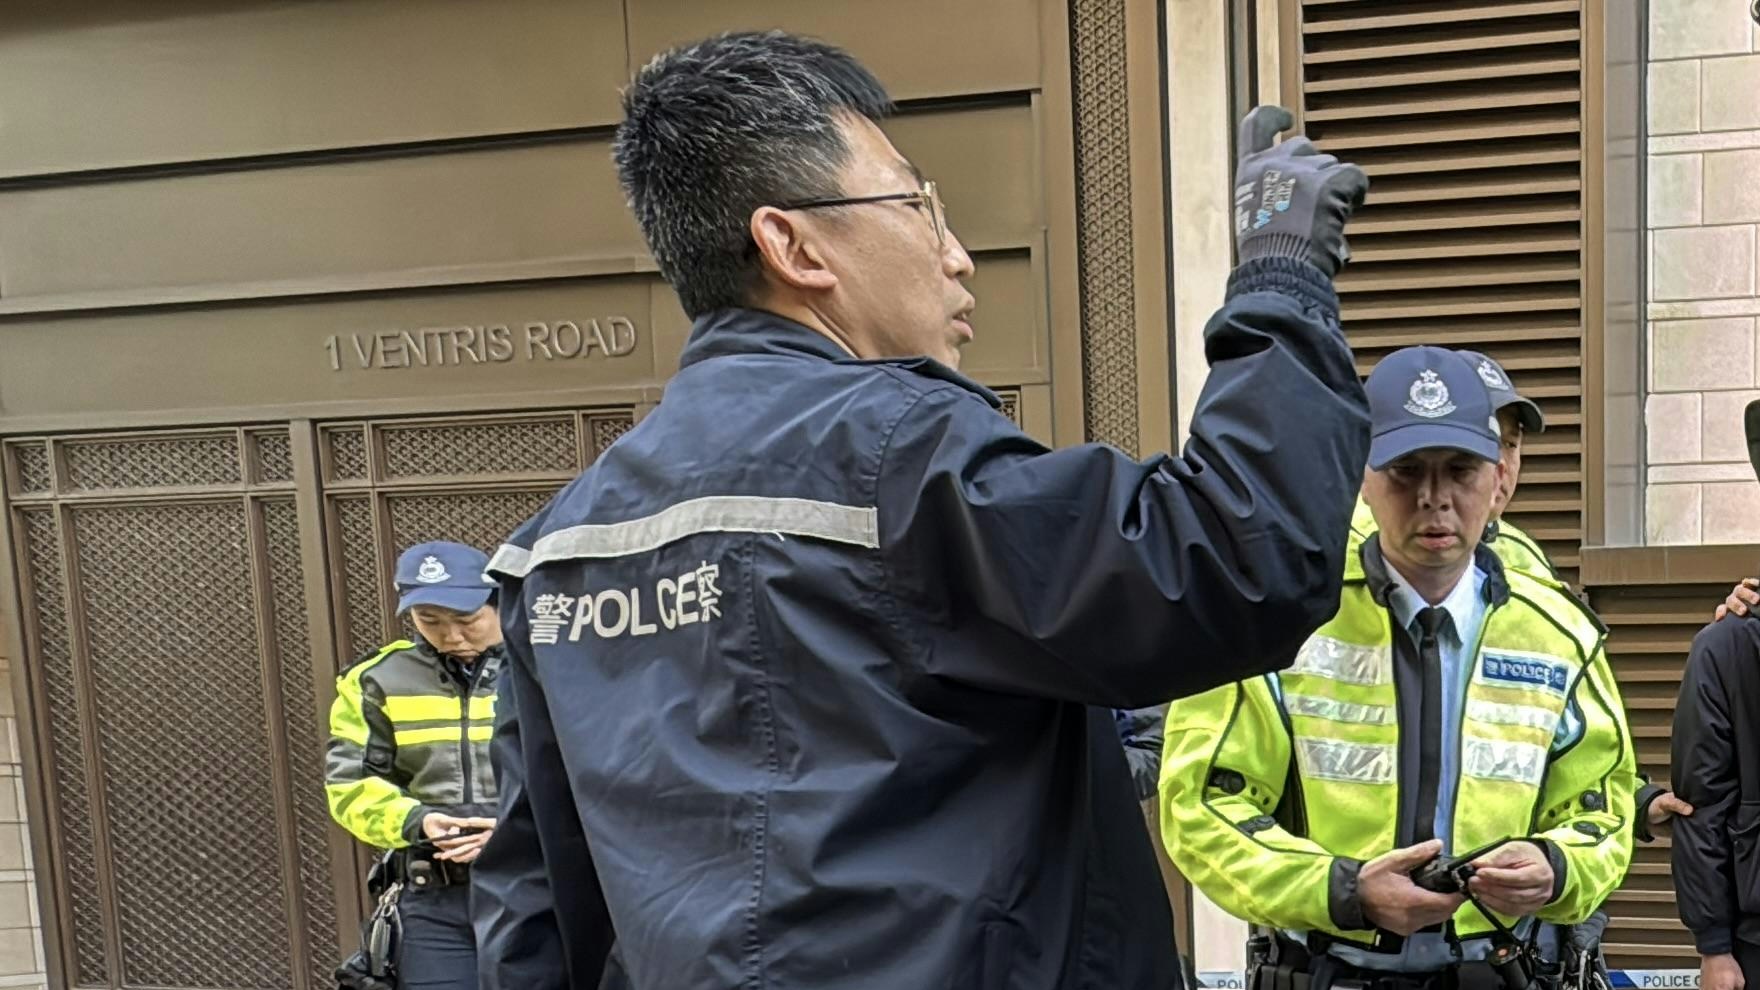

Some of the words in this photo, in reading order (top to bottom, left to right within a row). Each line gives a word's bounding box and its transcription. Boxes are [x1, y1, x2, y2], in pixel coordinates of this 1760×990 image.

[324, 334, 341, 371] 1
[352, 324, 515, 370] VENTRIS
[525, 315, 637, 362] ROAD
[529, 560, 723, 645] 警POLCE察
[1500, 661, 1552, 684] POLICE
[1643, 975, 1691, 988] POLICE
